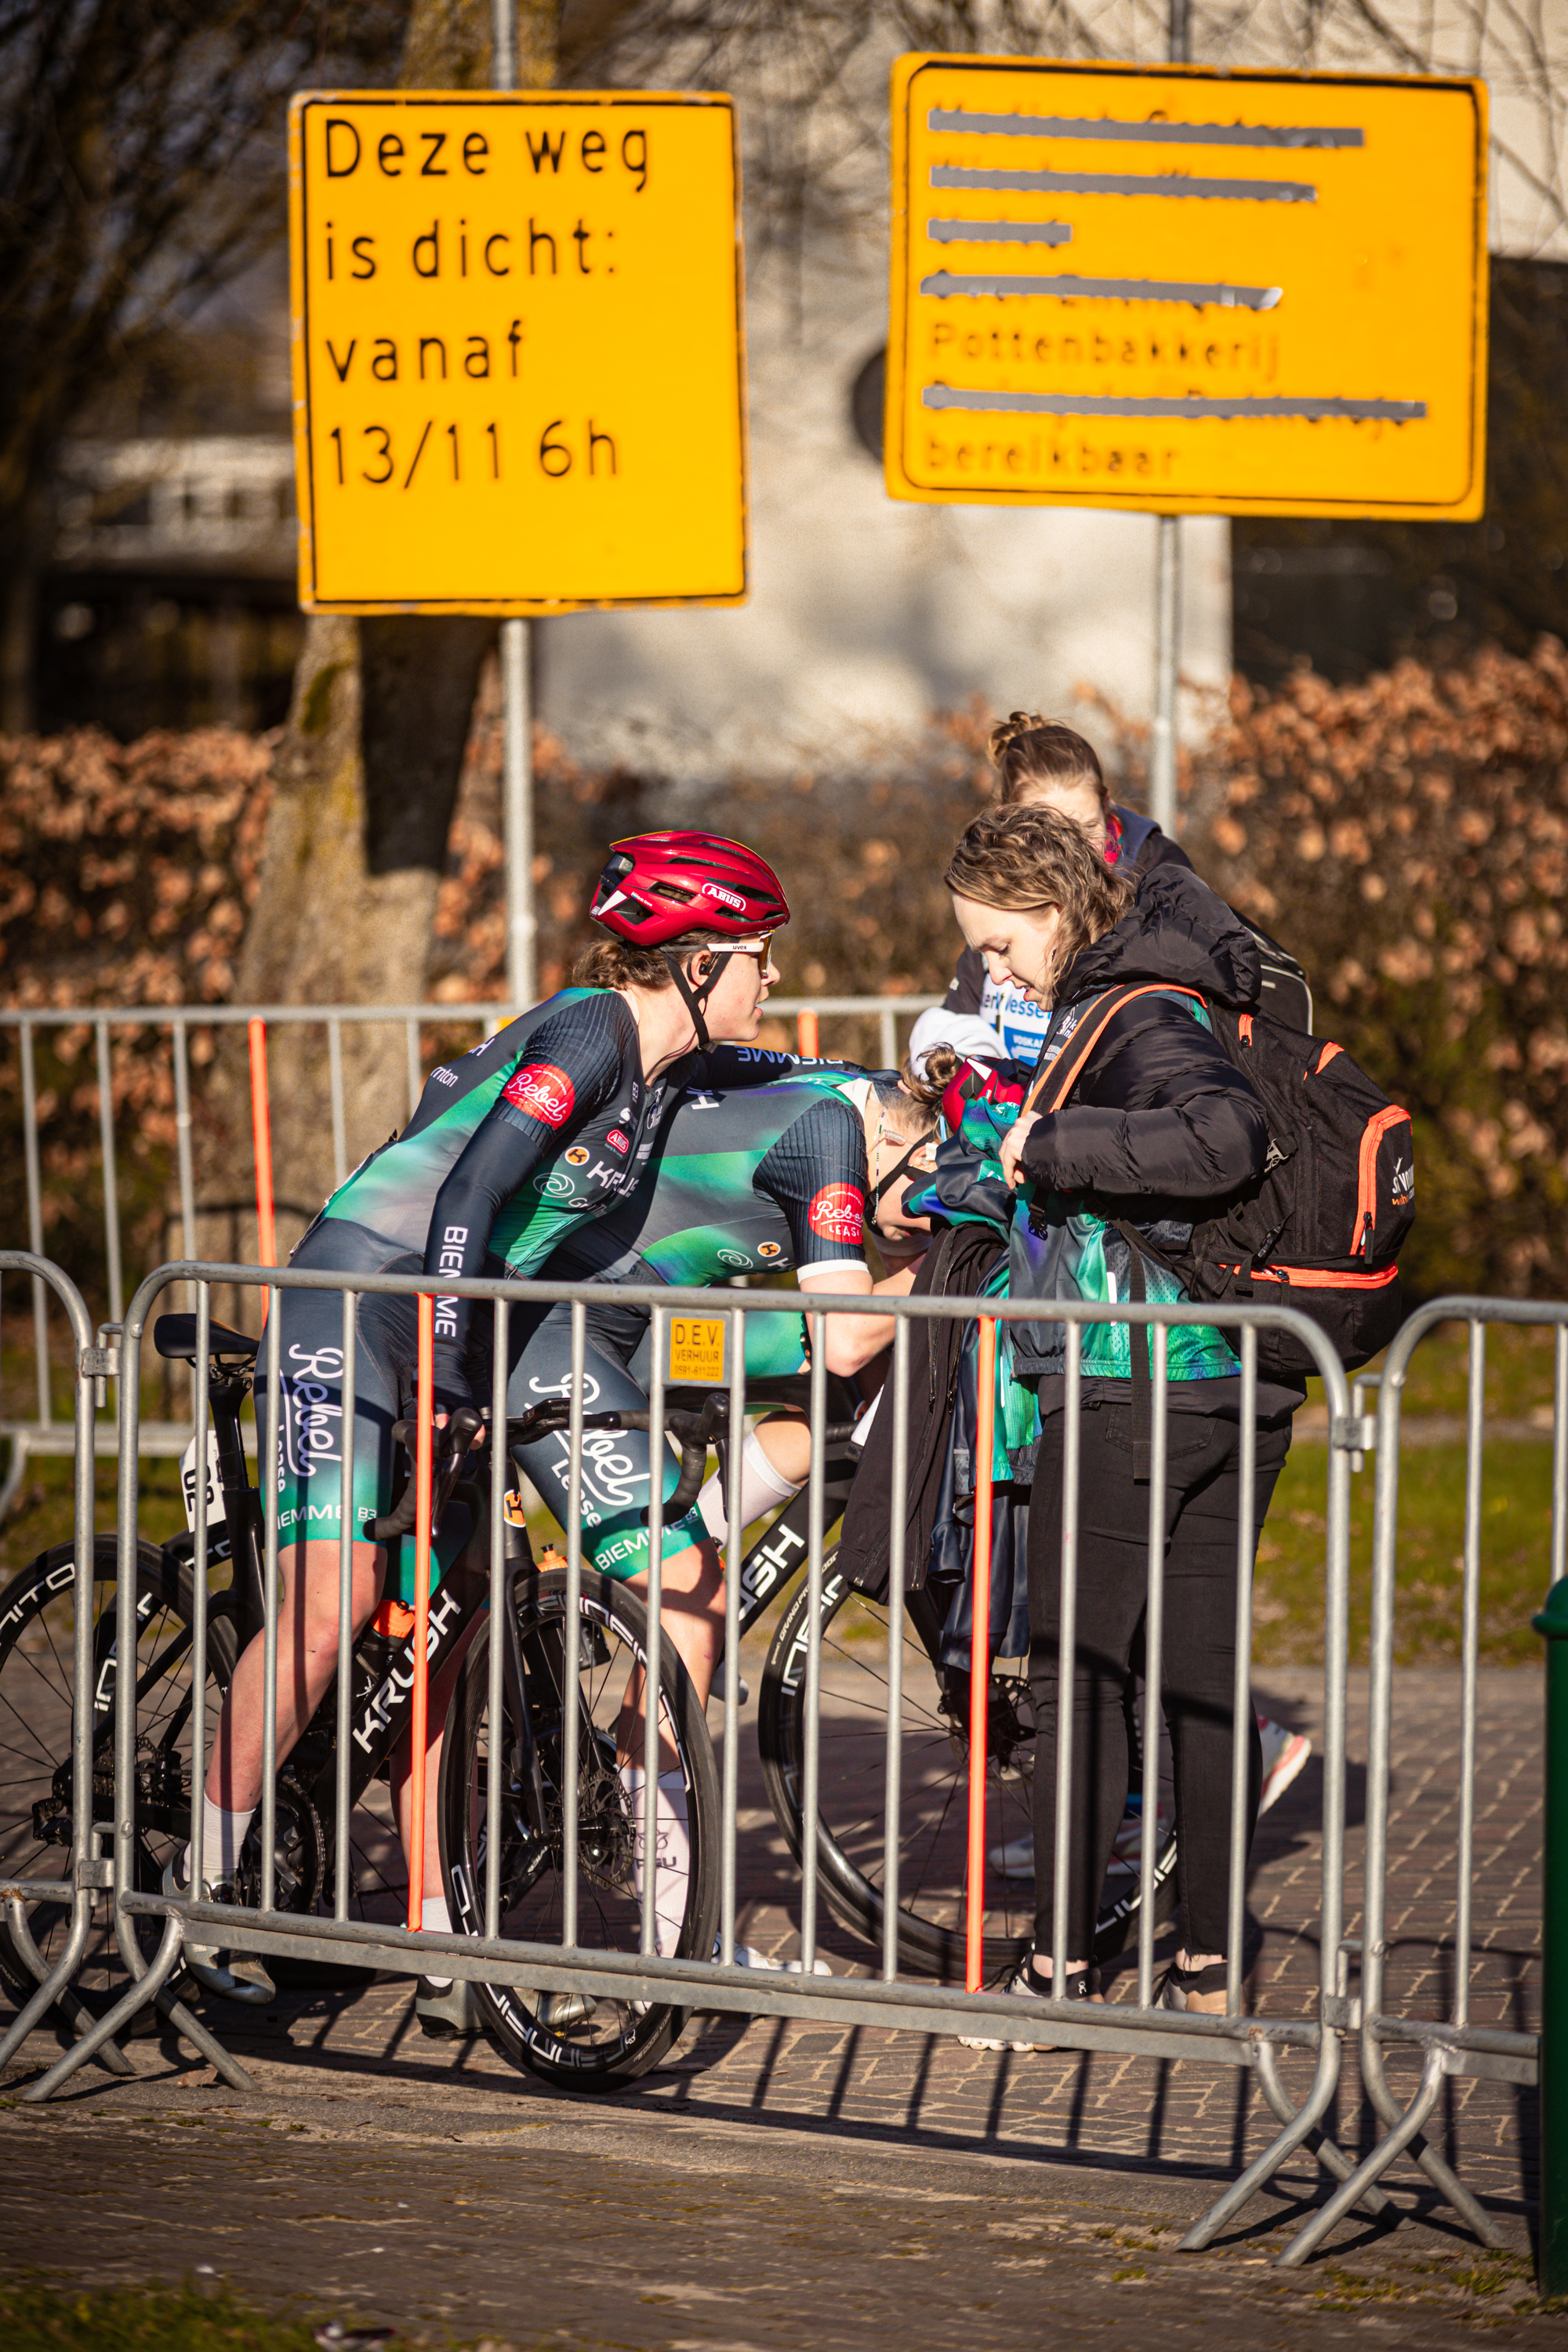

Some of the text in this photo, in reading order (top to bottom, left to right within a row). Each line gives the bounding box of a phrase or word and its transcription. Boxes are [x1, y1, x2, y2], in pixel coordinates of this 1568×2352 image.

[326, 118, 648, 193] Deze weg
[325, 217, 615, 281] is dicht:
[325, 318, 522, 382] vanaf
[927, 321, 1282, 382] Pottenbakkerij
[329, 419, 618, 489] 13/11 6h
[927, 436, 1178, 479] bereikbaar
[707, 886, 741, 909] ABUS
[507, 1073, 568, 1122] Rebel
[610, 1132, 627, 1151] ABUS
[675, 1349, 719, 1363] VERHUUR
[676, 1324, 720, 1346] D.E.V.
[284, 1344, 344, 1477] Rebel
[352, 1588, 462, 1755] KRUSH
